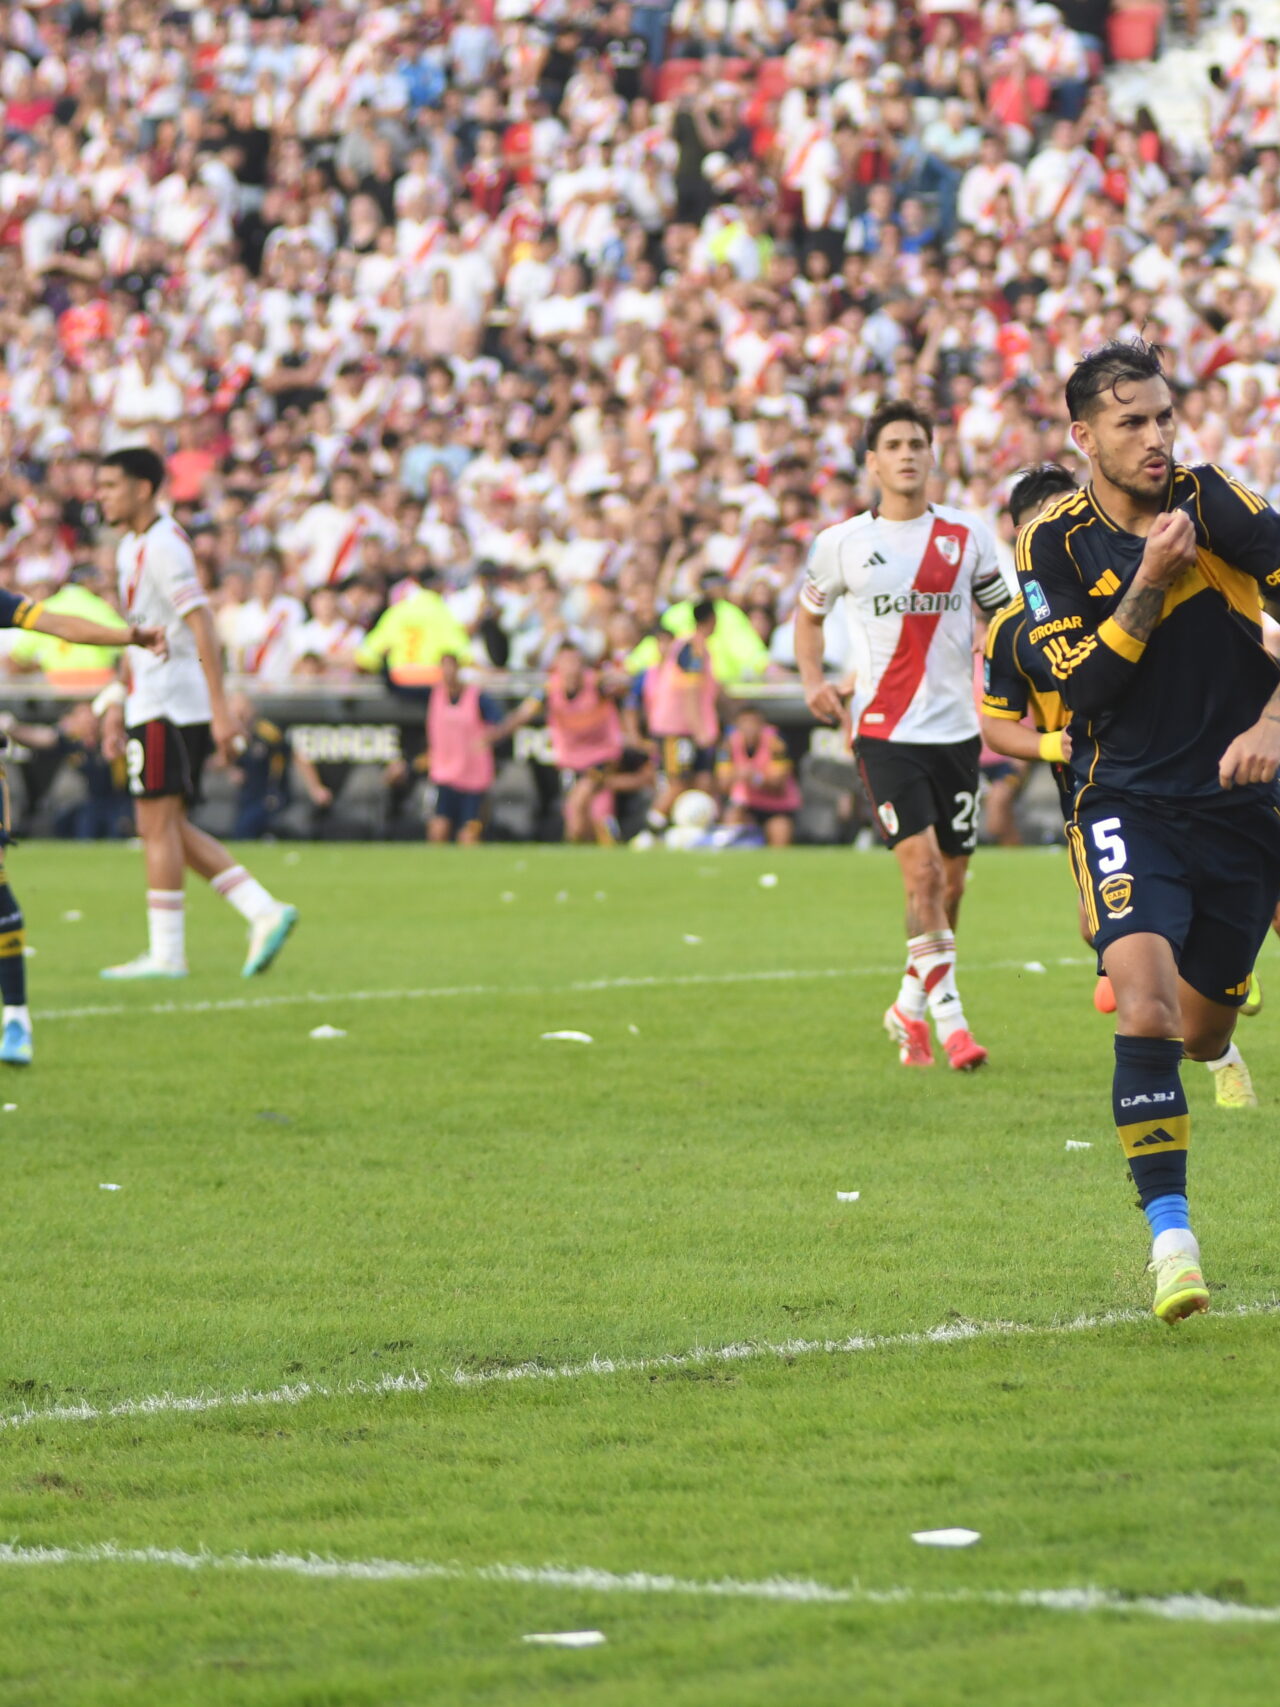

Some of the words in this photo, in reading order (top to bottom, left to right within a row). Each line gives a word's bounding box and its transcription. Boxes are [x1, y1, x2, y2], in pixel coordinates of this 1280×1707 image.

[873, 591, 962, 617] Betano
[1091, 816, 1128, 875] 5
[1120, 1091, 1176, 1108] CABJ
